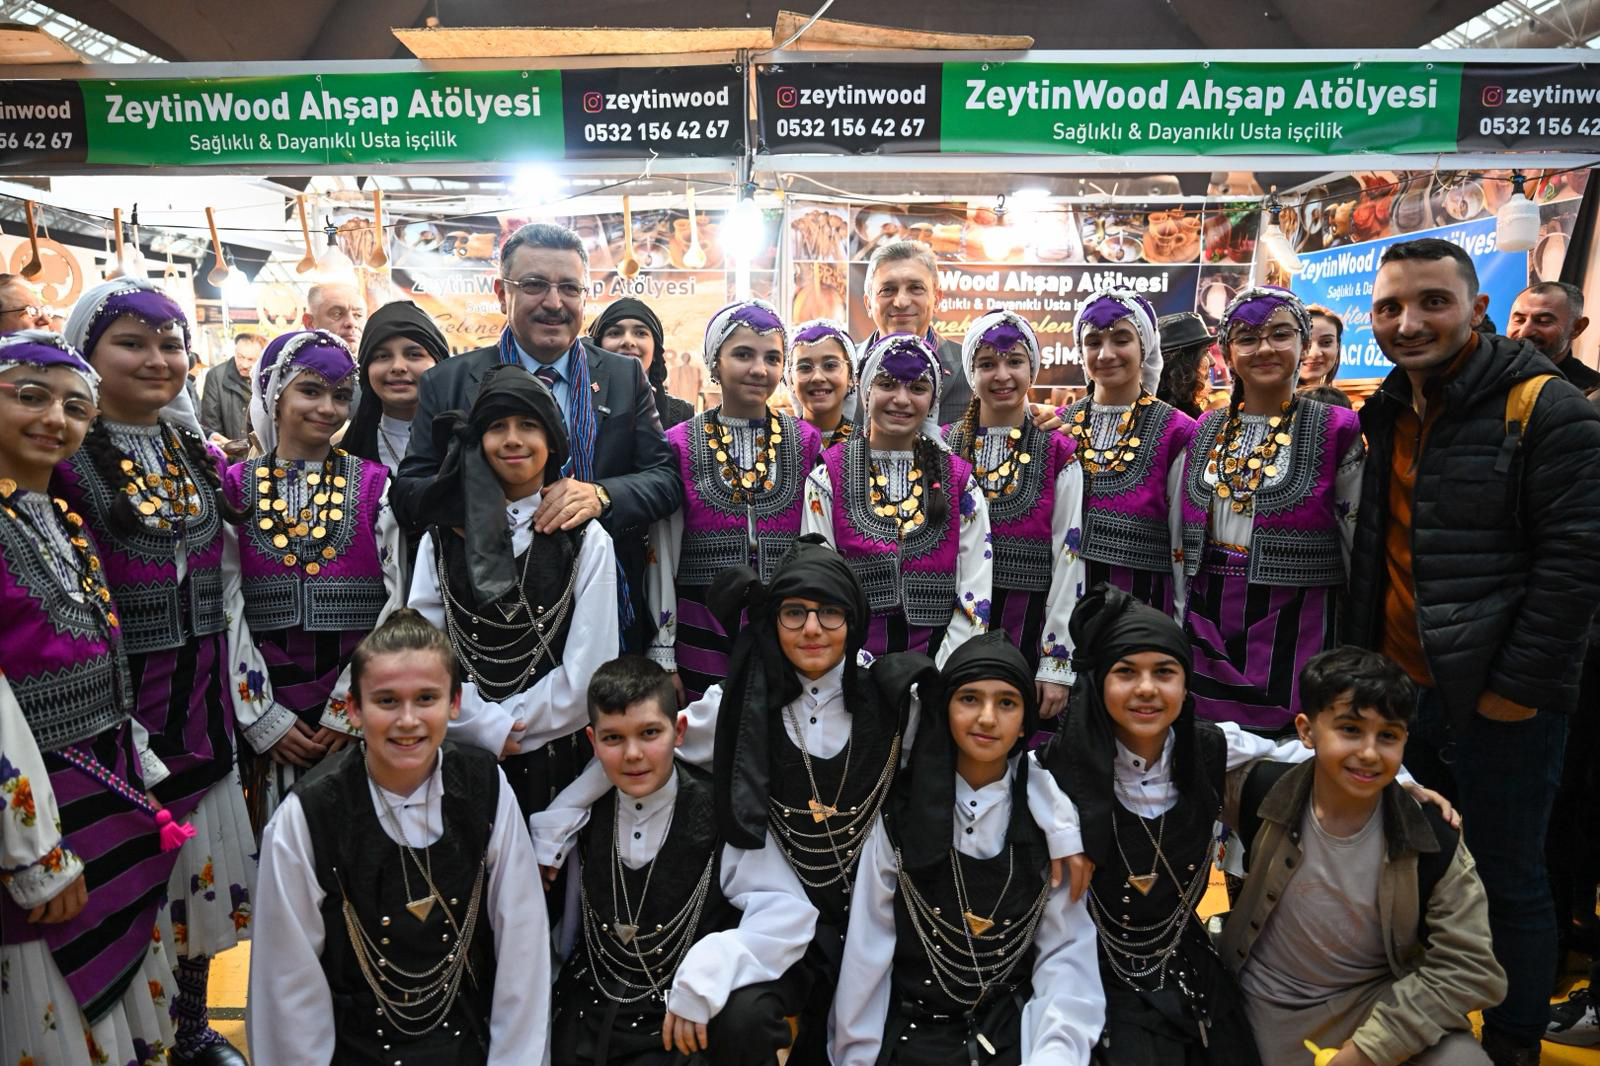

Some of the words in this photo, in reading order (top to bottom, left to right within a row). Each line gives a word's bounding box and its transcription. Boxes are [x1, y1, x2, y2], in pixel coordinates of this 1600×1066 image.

[105, 92, 290, 129] ZeytinWood
[300, 90, 399, 125] Ahşap
[407, 86, 541, 124] Atölyesi
[605, 86, 729, 115] zeytinwood
[800, 85, 926, 110] zeytinwood
[965, 79, 1168, 117] ZeytinWood
[1176, 79, 1285, 116] Ahşap
[1293, 78, 1437, 116] Atölyesi
[584, 123, 632, 142] 0532
[638, 122, 672, 140] 156
[676, 121, 701, 139] 42
[705, 119, 730, 138] 67
[776, 118, 825, 137] 0532
[831, 118, 866, 136] 156
[870, 119, 895, 137] 42
[900, 118, 925, 137] 67
[1053, 122, 1122, 144] Sağlıklı
[1128, 124, 1142, 138] &
[1148, 122, 1234, 141] Dayanıklı
[1240, 123, 1282, 140] Usta
[1287, 122, 1343, 140] işçilik
[1480, 117, 1531, 135] 0532
[1537, 117, 1573, 135] 156
[23, 132, 46, 149] 42
[50, 132, 73, 149] 67
[189, 133, 253, 154] Sağlıklı
[259, 134, 272, 150] &
[277, 132, 356, 153] Dayanıklı
[361, 132, 401, 148] Usta
[405, 130, 457, 150] işçilik
[1300, 248, 1375, 284] ZeytinWood
[1003, 271, 1073, 296] Ahşap
[1355, 284, 1362, 296] &
[974, 298, 984, 311] &
[1043, 298, 1071, 312] Usta
